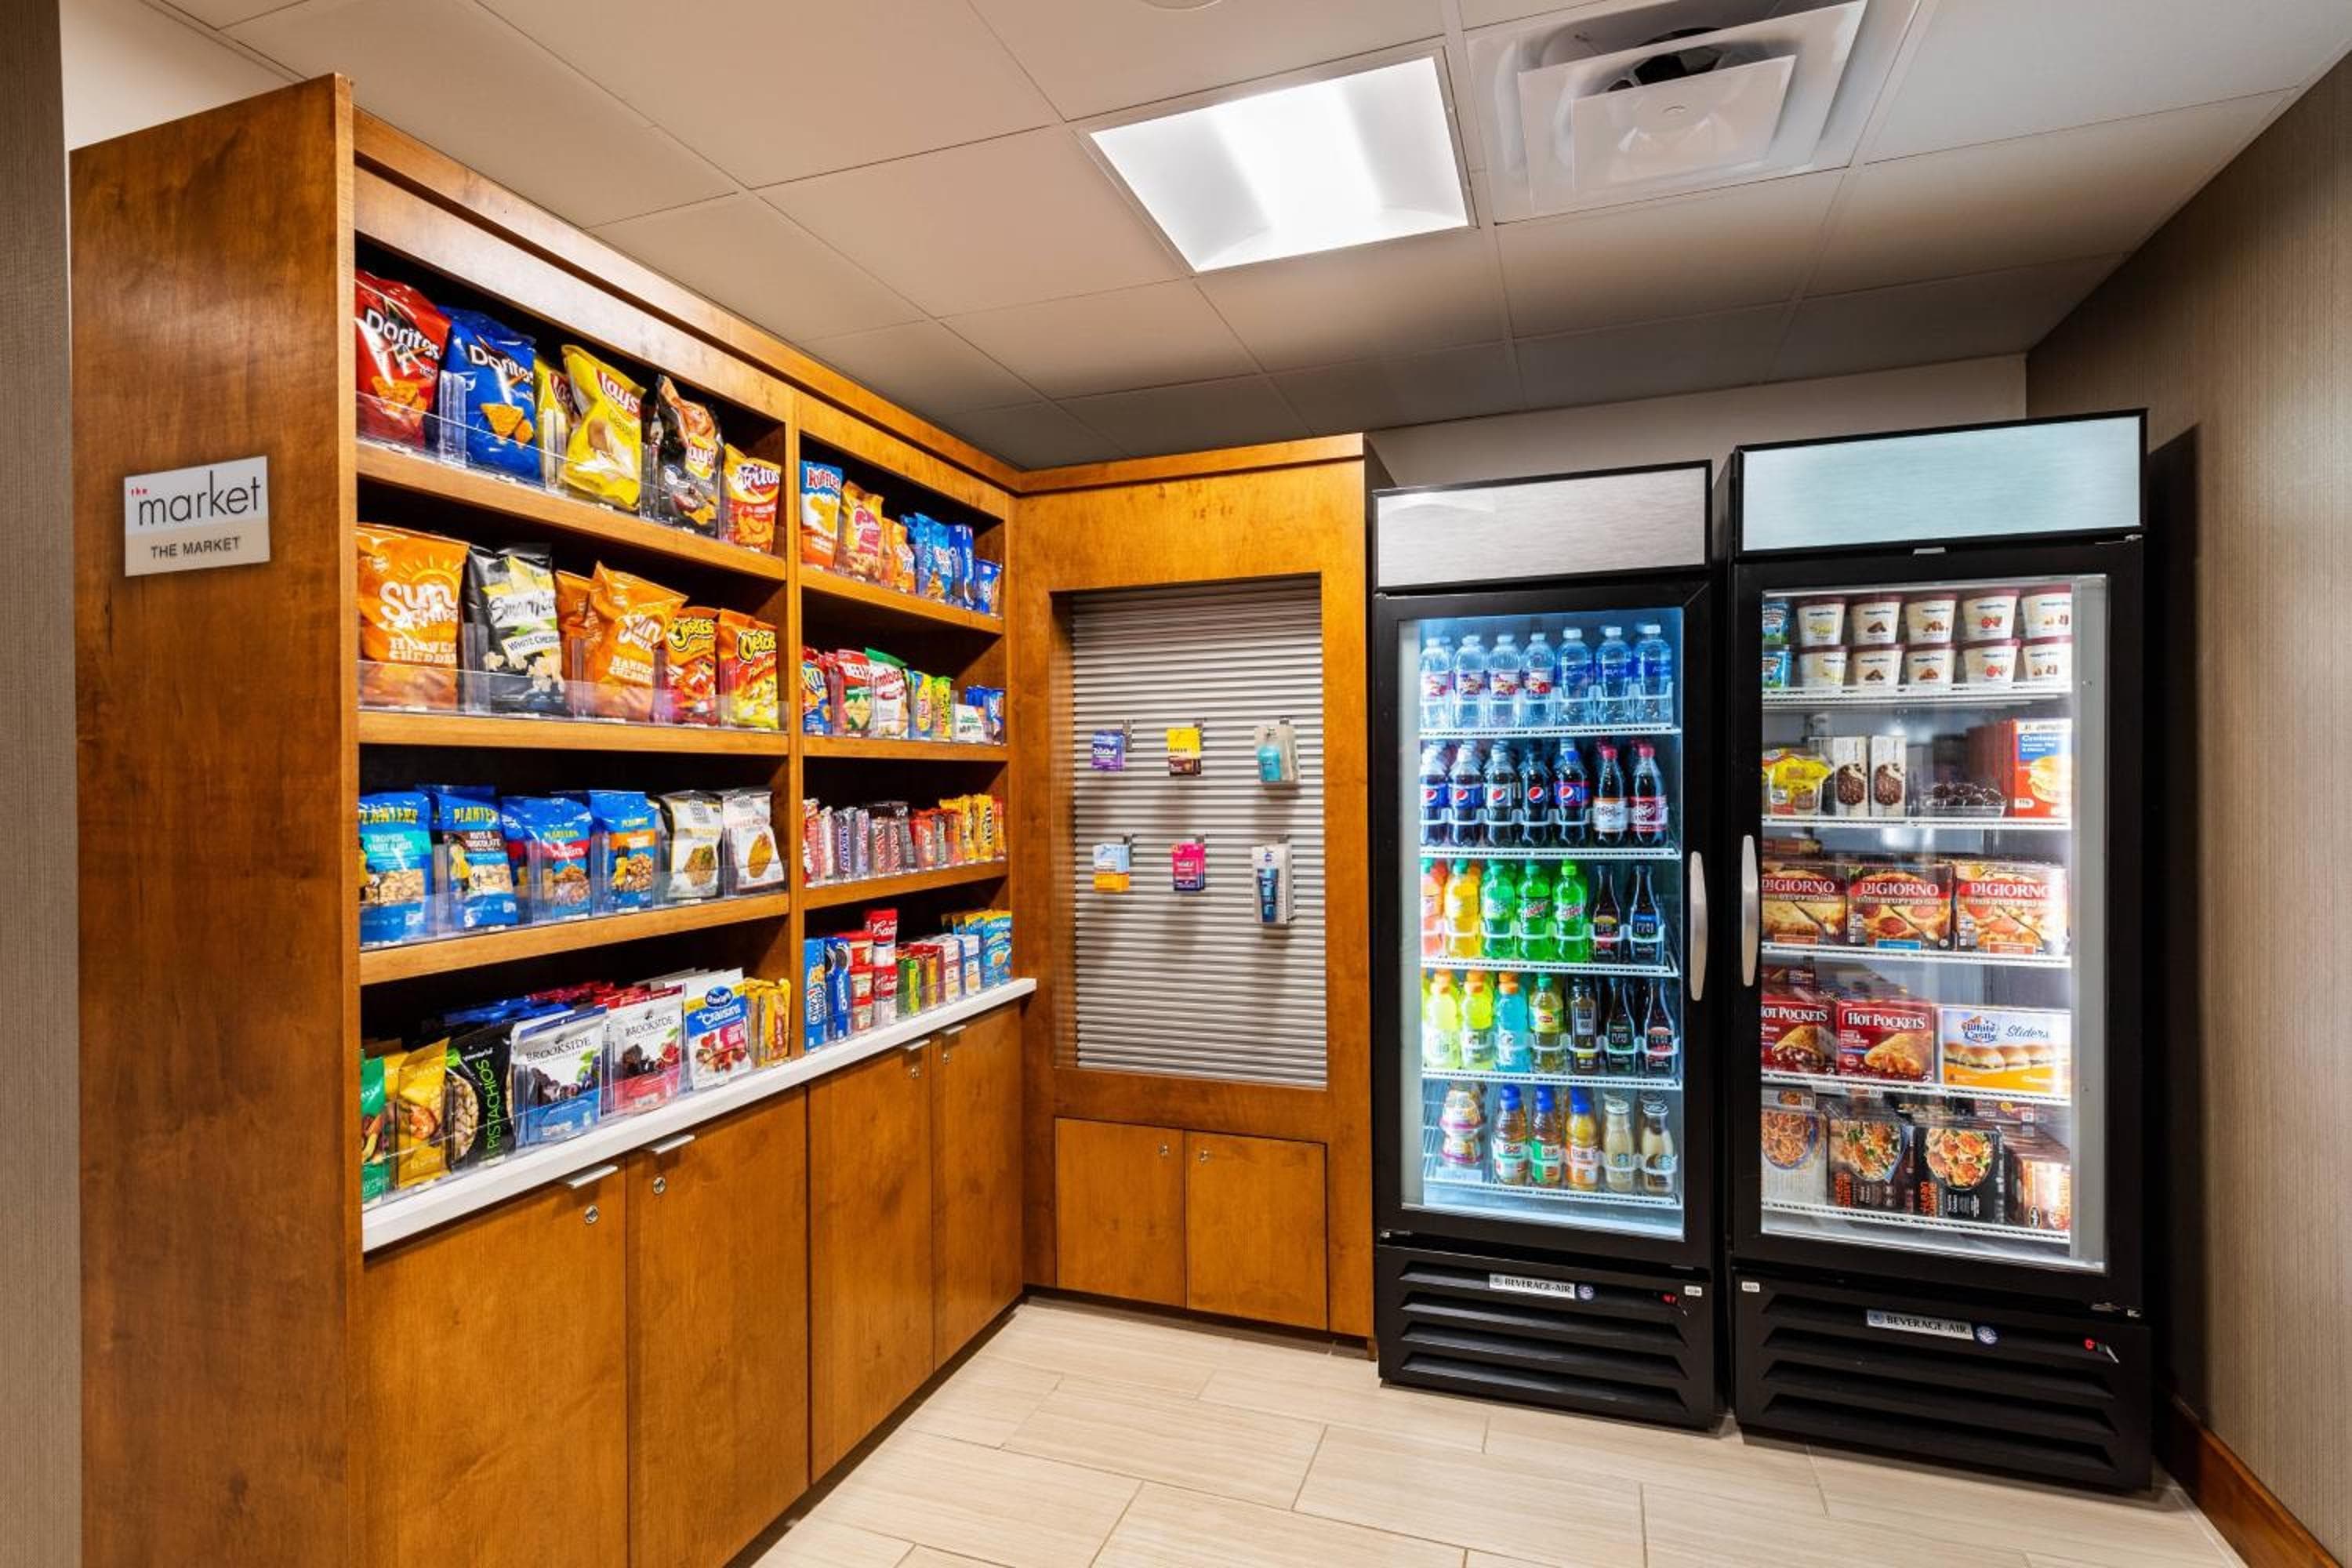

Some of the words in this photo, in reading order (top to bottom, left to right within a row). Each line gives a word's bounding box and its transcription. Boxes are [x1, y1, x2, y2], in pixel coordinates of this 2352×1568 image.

[365, 308, 439, 360] Doritos
[470, 344, 534, 383] Doritos
[740, 463, 779, 490] Fritos
[139, 470, 261, 525] market
[151, 543, 178, 559] THE
[182, 535, 241, 555] MARKET
[379, 581, 459, 624] Sun
[1762, 878, 1835, 895] DIGIORNO
[1861, 881, 1939, 897] DIGIORNO
[1970, 882, 2050, 898] DIGIORNO
[626, 1016, 674, 1036] BROOKSIDE
[1761, 1007, 1777, 1018] OT
[1779, 1008, 1828, 1022] POCKETS
[1847, 1012, 1872, 1025] HOT
[1873, 1014, 1926, 1029] POCKETS
[525, 1037, 591, 1062] BROOKSIDE
[476, 1058, 502, 1150] PISTACHIOS
